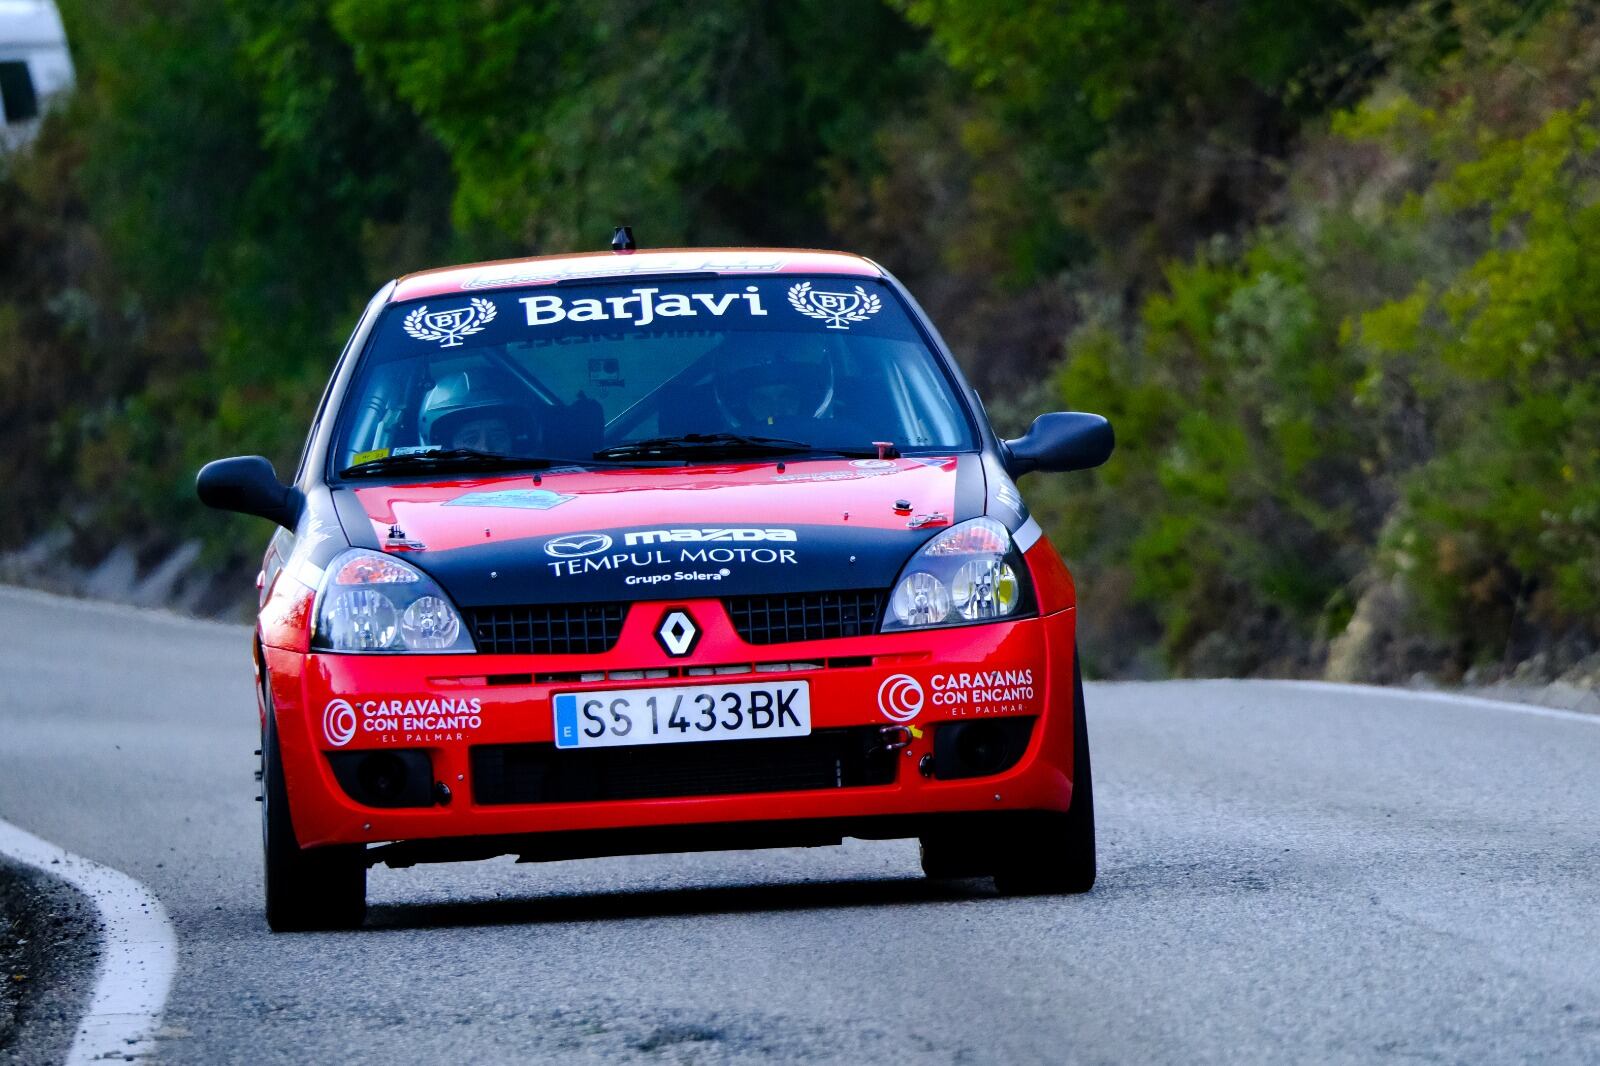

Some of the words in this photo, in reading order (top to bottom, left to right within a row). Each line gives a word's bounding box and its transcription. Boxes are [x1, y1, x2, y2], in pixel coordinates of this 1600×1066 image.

[518, 286, 768, 326] BarJavi
[819, 294, 848, 312] BJ
[434, 312, 463, 329] BJ
[625, 528, 798, 546] mazda
[548, 550, 671, 578] TEMPUL
[681, 548, 799, 565] MOTOR
[625, 575, 671, 585] Grupo
[931, 669, 1034, 690] CARAVANAS
[932, 690, 968, 705] CON
[972, 686, 1034, 703] ENCANTO
[363, 697, 481, 717] CARAVANAS
[974, 704, 1024, 714] PALMAR
[363, 716, 399, 732] CON
[403, 714, 482, 731] ENCANTO
[583, 699, 633, 738] SS
[405, 732, 464, 742] PALMAR
[563, 726, 572, 738] E
